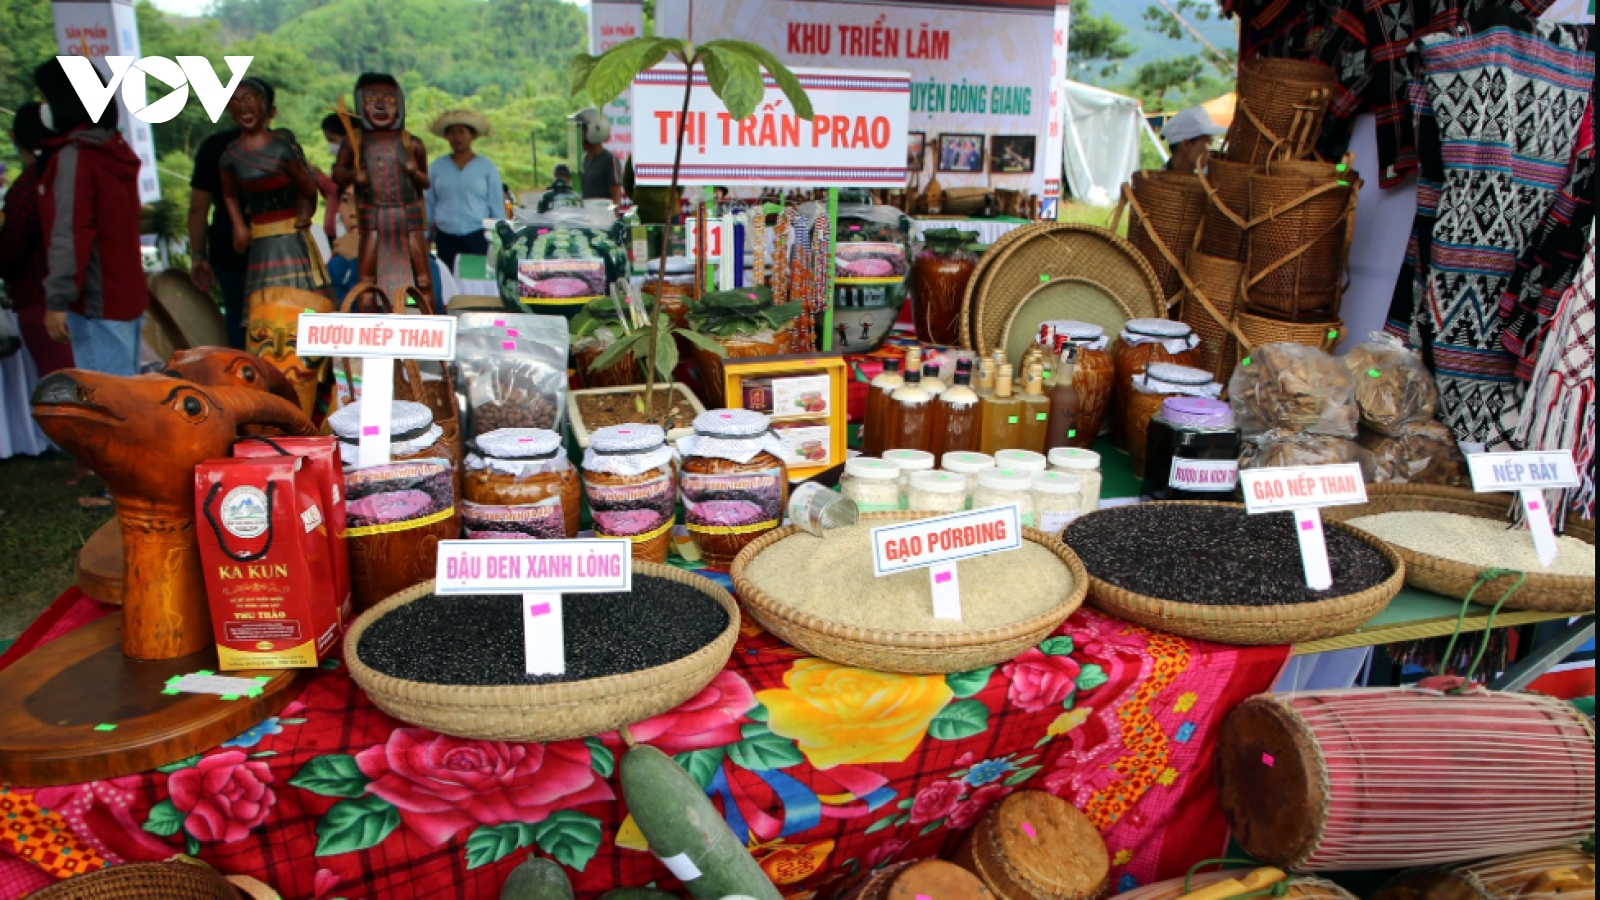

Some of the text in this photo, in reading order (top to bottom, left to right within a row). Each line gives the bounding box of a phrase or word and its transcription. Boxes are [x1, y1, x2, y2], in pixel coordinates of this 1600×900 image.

[787, 14, 949, 60] KHU TRIỂN LÃM
[910, 76, 946, 119] UYỆN
[949, 77, 986, 114] ĐÔNG
[990, 86, 1031, 116] GIANG
[654, 100, 891, 154] THỊ TRẤN PRAO
[308, 322, 444, 349] RƯỢU NẾP THAN
[1253, 472, 1357, 503] GẠO NẾP THAN
[1492, 458, 1525, 483] NẾP
[885, 519, 1006, 563] GẠO PƠRĐING
[218, 563, 288, 580] KA KUN
[447, 549, 621, 585] ĐẬU ĐEN XANH LÒNG
